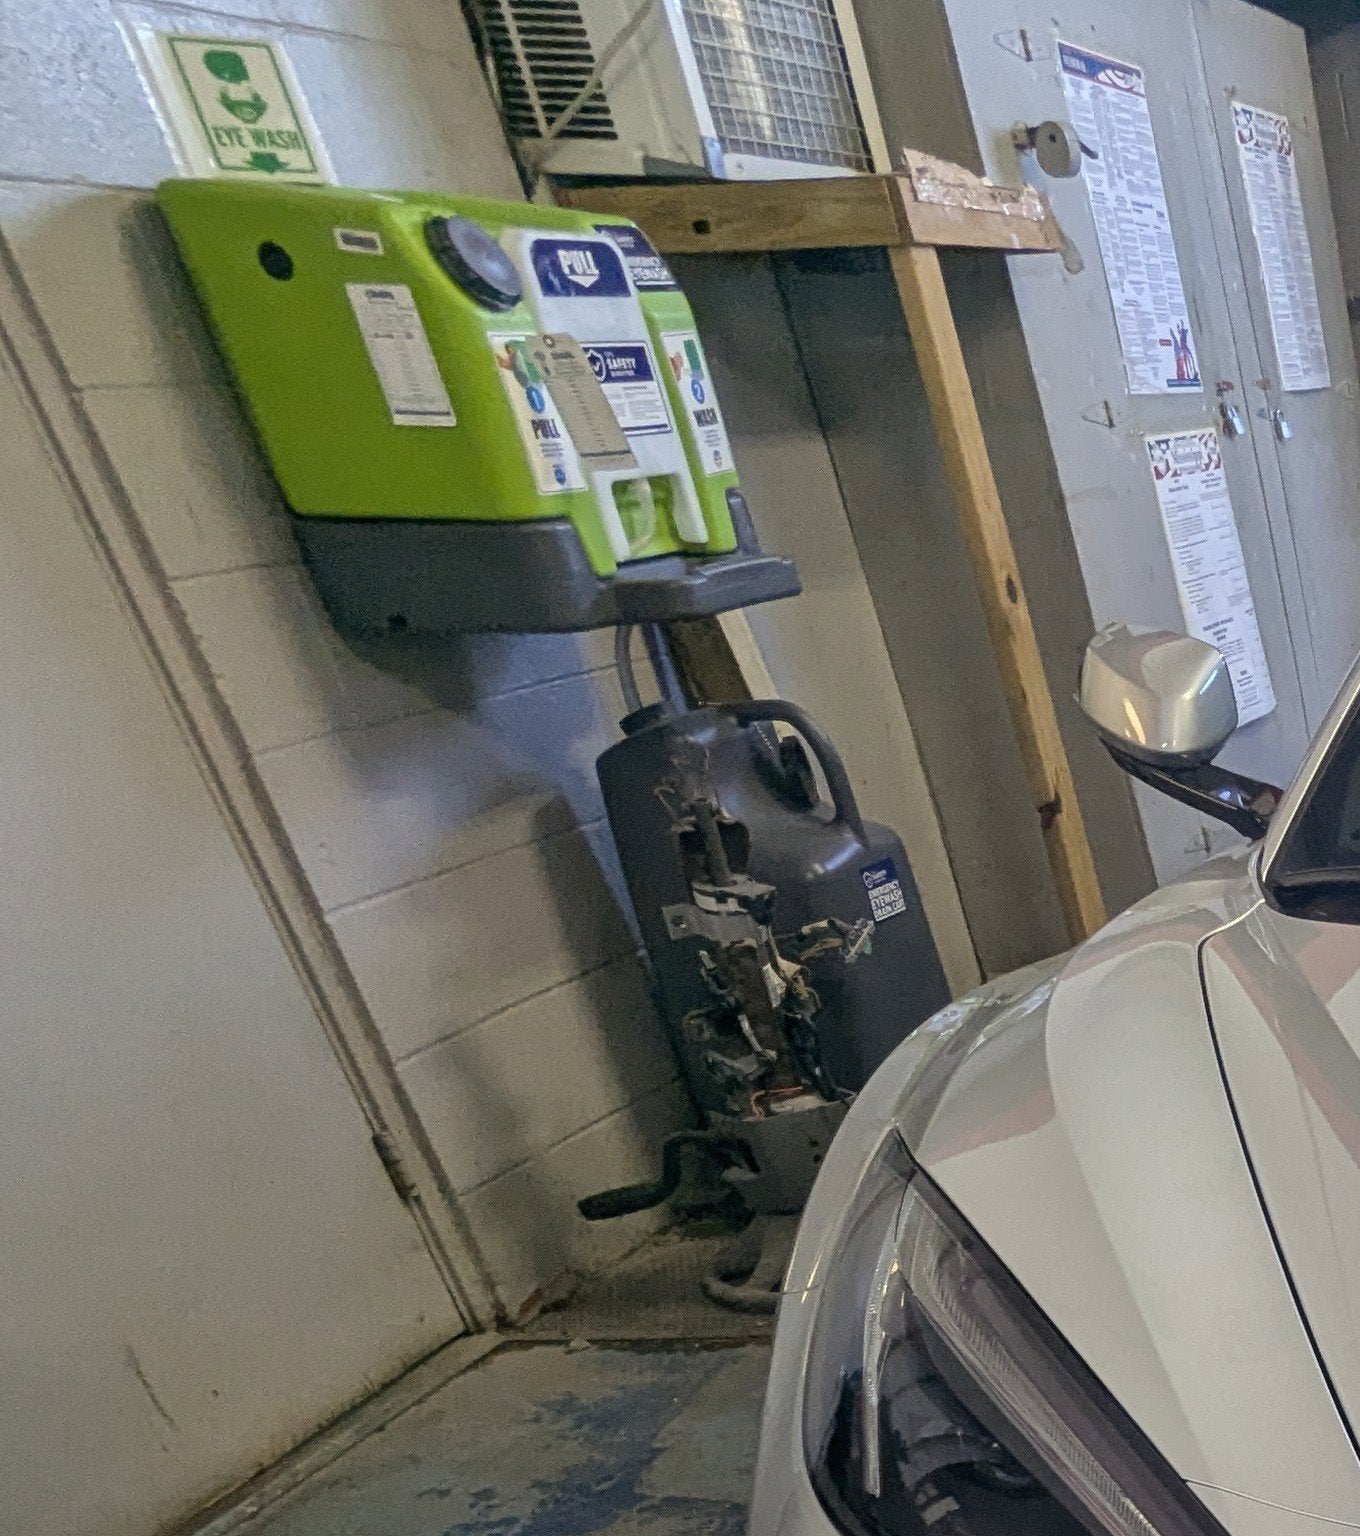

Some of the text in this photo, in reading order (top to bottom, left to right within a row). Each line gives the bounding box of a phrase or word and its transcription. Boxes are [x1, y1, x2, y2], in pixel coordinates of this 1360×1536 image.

[210, 126, 303, 150] EYE WASH
[556, 249, 600, 275] PULL
[531, 418, 561, 440] PULL
[871, 890, 903, 910] EYEWASH
